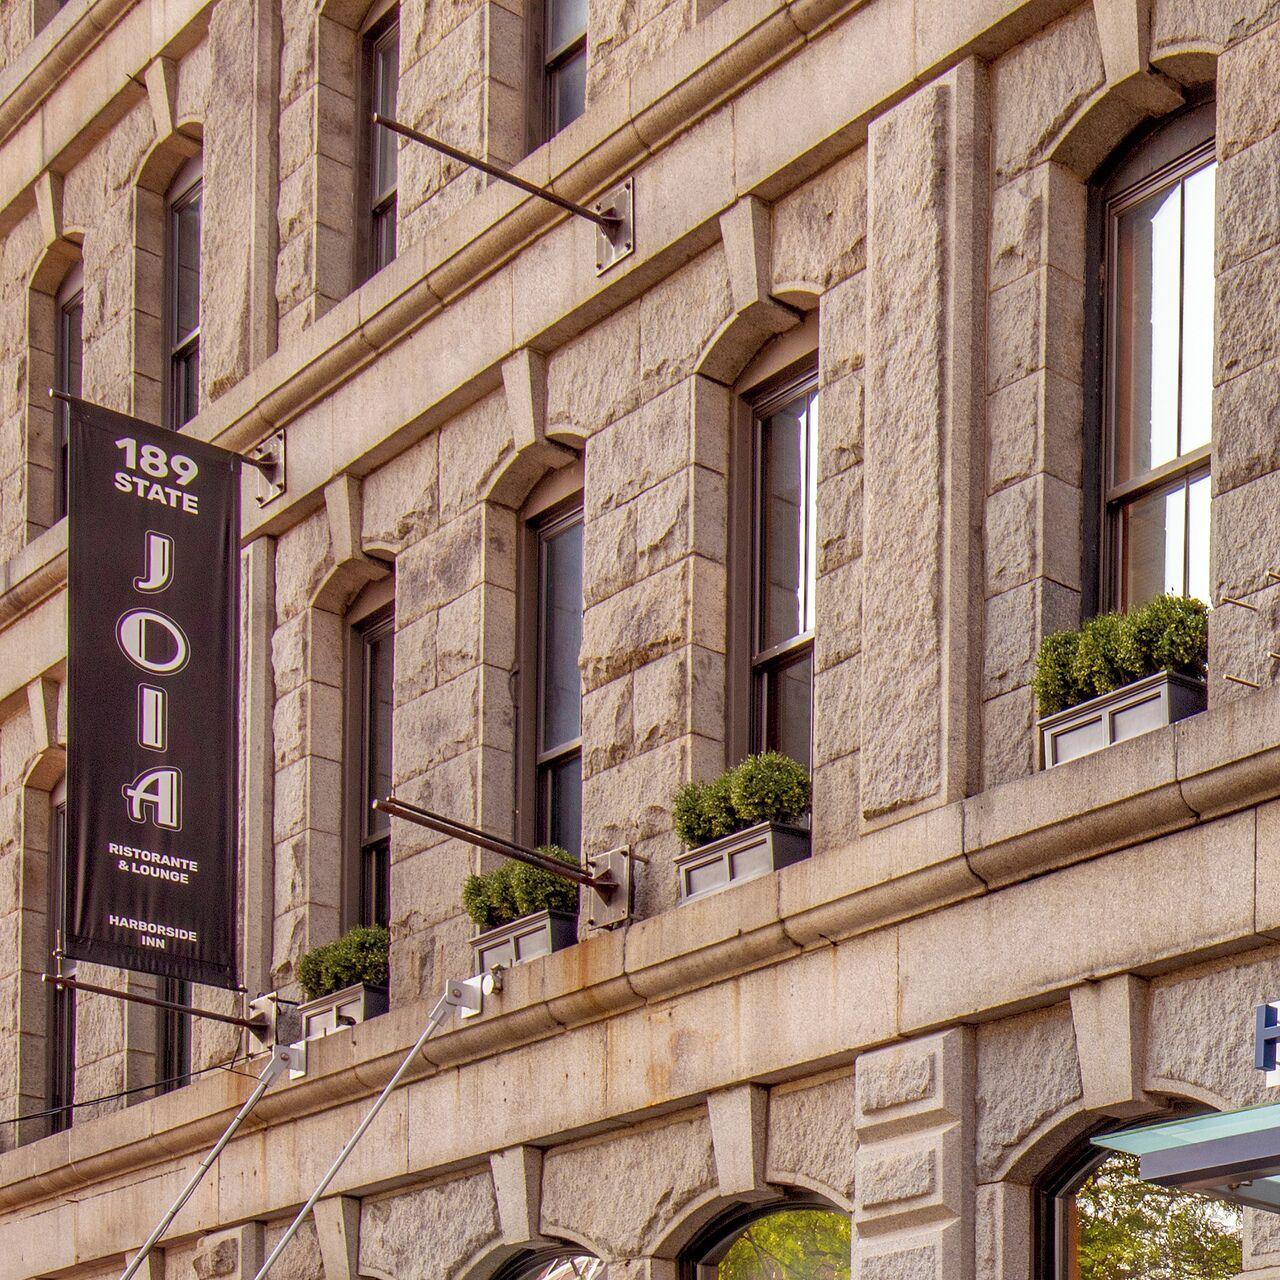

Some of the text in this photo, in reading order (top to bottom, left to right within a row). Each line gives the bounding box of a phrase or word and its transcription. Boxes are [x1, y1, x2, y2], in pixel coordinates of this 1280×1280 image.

[115, 437, 199, 487] 189
[114, 472, 199, 516] STATE
[115, 530, 191, 831] JOIA
[108, 842, 198, 872] RISTORANTE
[118, 860, 189, 884] & LOUNGE
[109, 915, 197, 942] HARBORSIDE
[141, 935, 166, 949] INN
